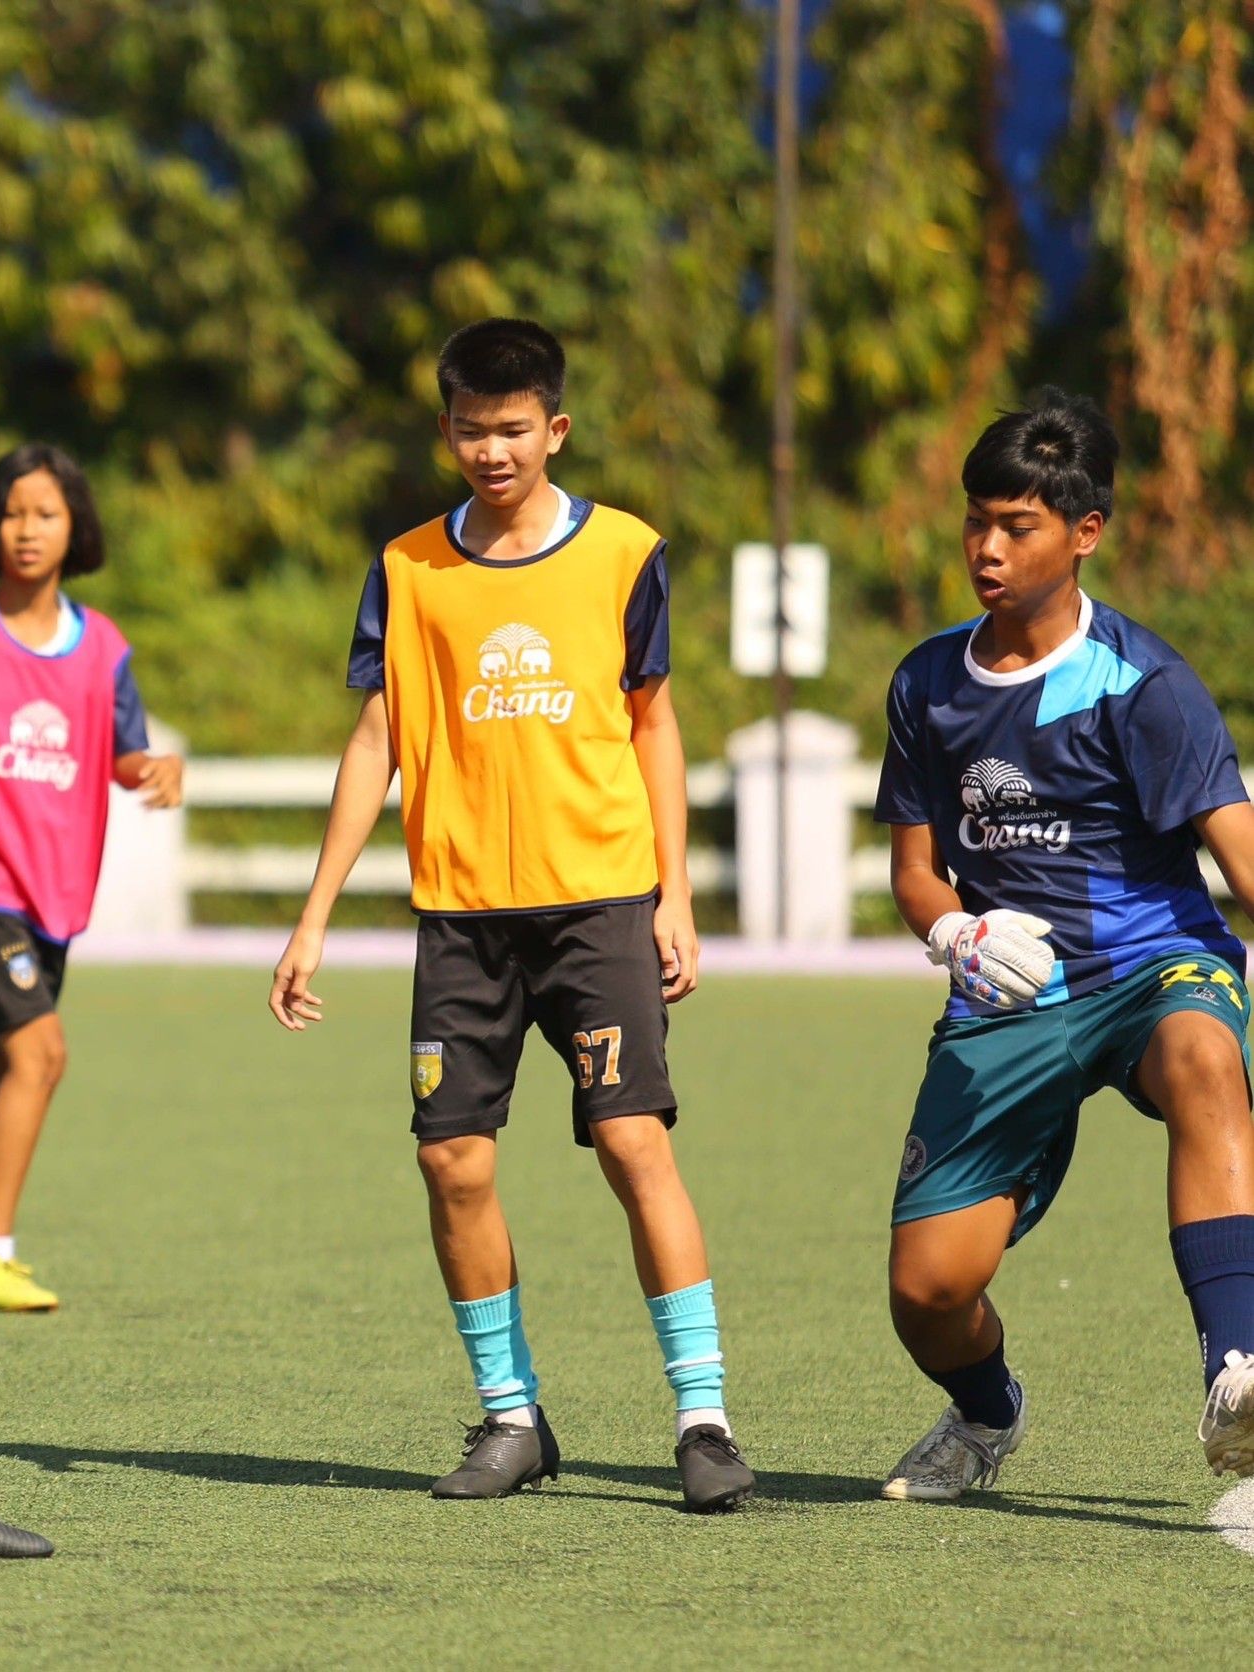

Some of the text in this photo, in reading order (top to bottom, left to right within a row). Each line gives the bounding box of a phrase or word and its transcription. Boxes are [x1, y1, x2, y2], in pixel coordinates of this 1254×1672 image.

[462, 683, 575, 724] Chang
[958, 813, 1071, 854] Chang
[572, 1026, 621, 1089] 67
